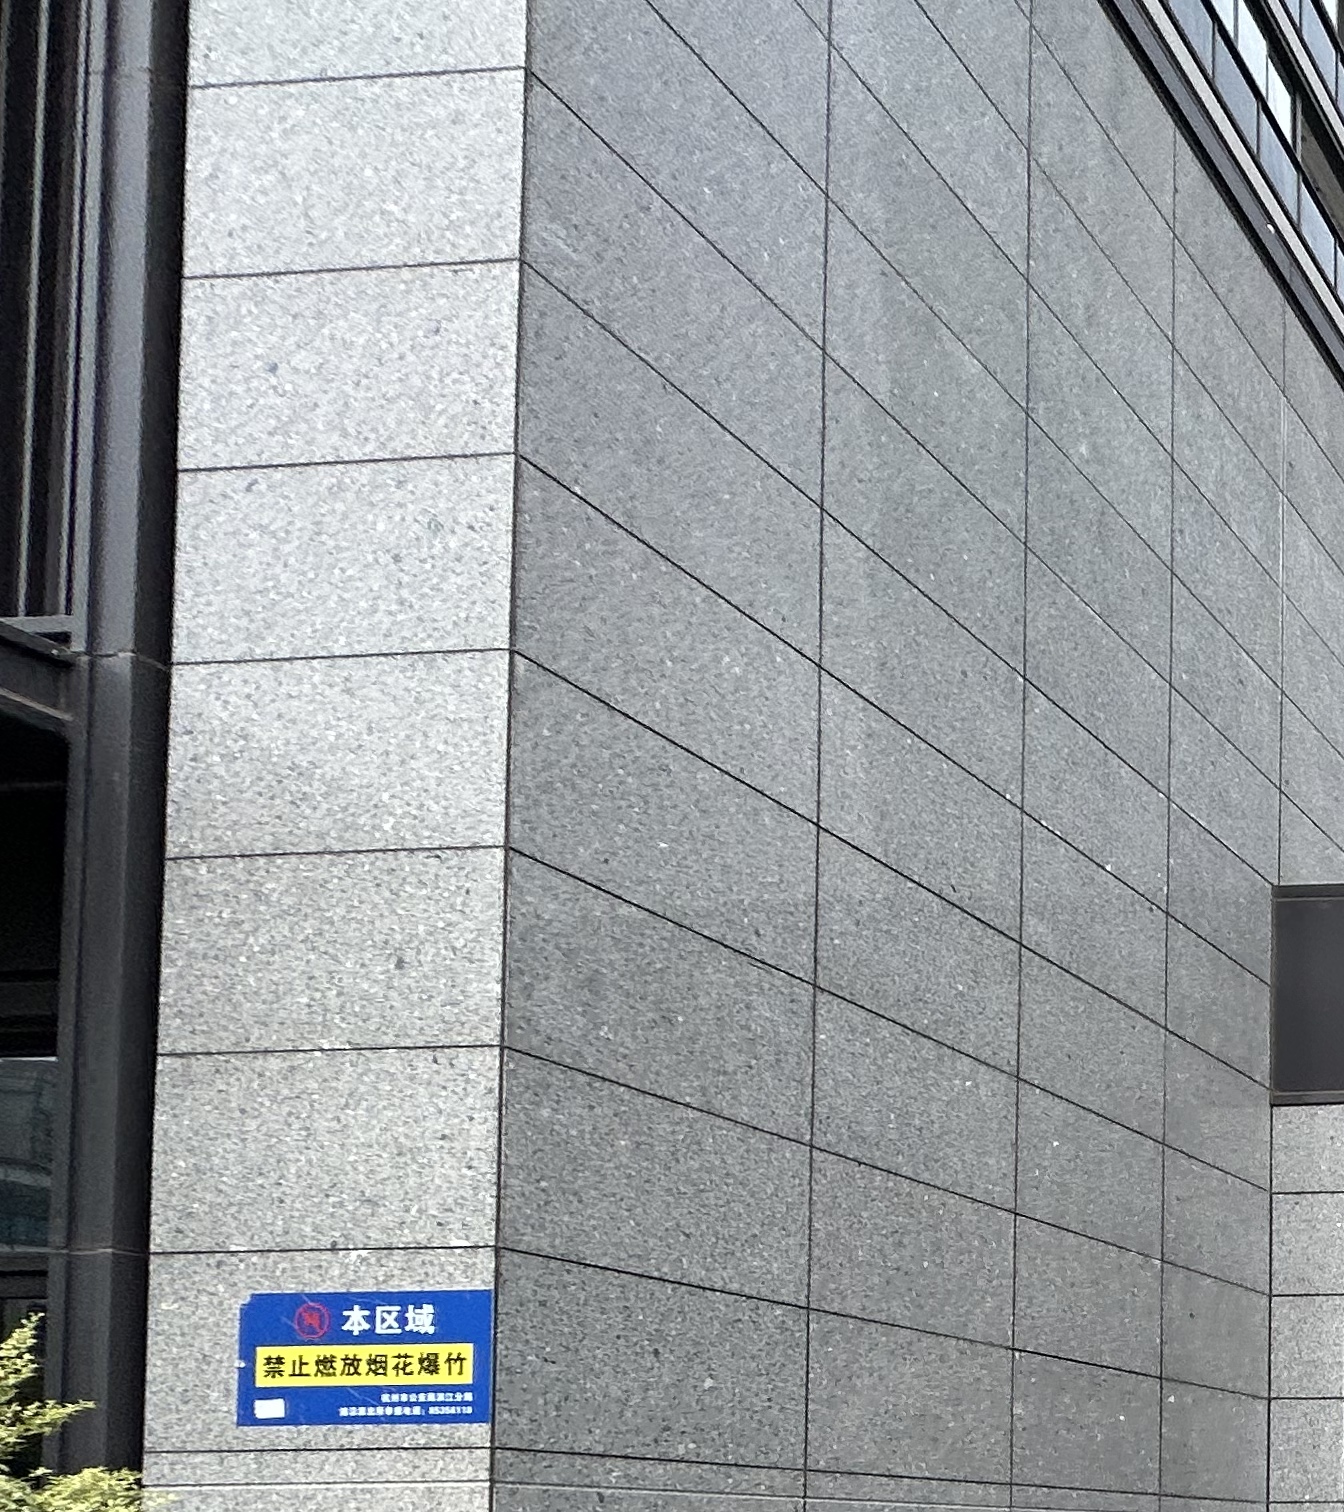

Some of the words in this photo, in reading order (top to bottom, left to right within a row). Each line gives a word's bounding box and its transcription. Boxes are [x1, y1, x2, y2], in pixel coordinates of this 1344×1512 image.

[341, 1304, 435, 1336] 本区域
[263, 1352, 467, 1379] 禁止燃放烟花爆竹
